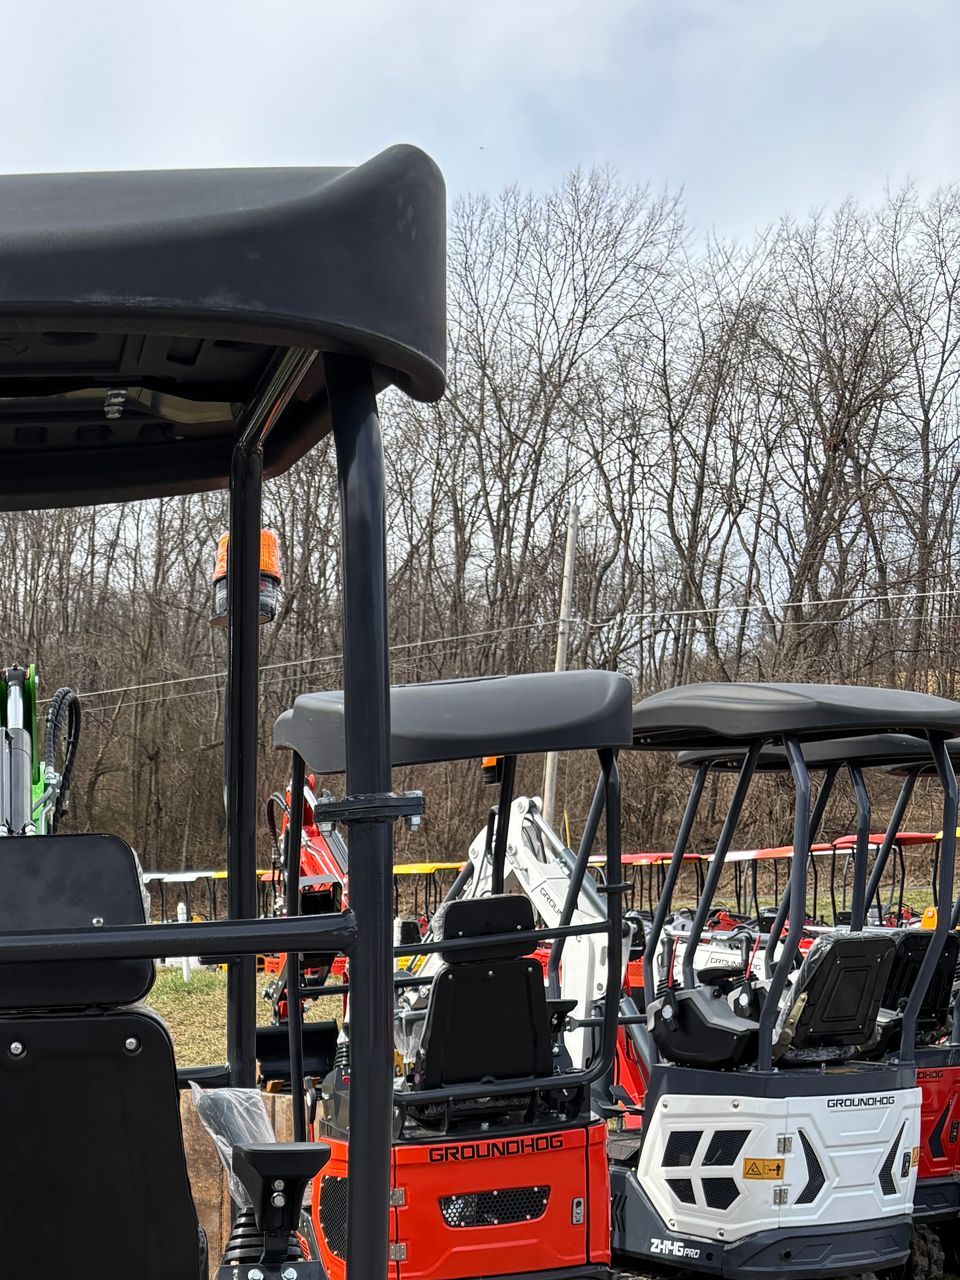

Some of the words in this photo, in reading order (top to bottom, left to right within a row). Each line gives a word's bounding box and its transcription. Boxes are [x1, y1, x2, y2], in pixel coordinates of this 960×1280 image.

[827, 1096, 895, 1108] GROUNDHOG
[429, 1134, 563, 1163] GROUNDHOG
[650, 1238, 685, 1256] ZH14G
[683, 1247, 700, 1259] PRO
